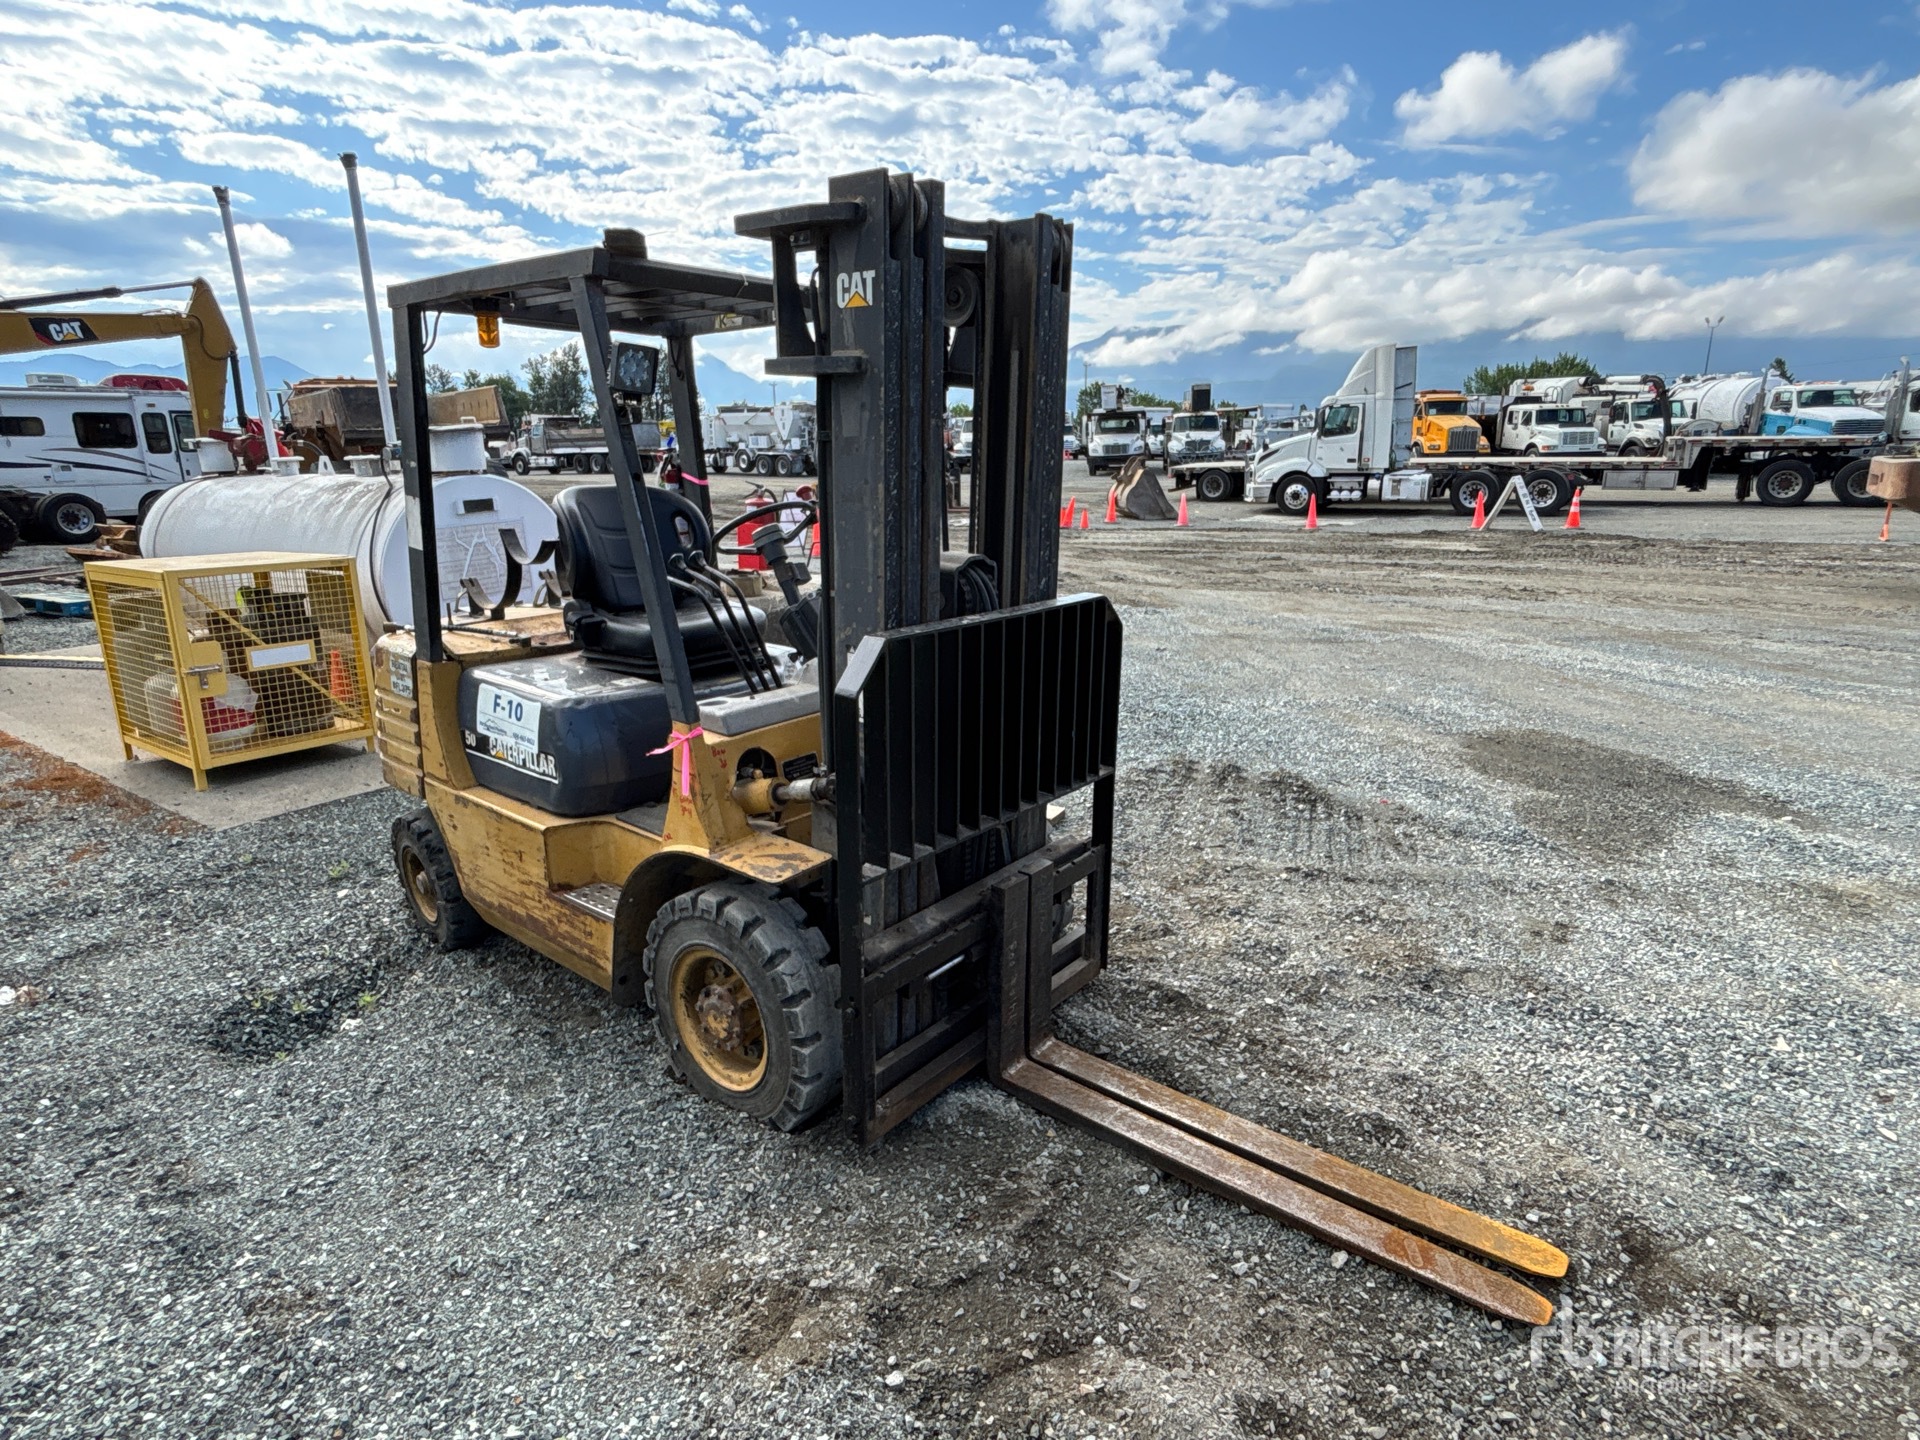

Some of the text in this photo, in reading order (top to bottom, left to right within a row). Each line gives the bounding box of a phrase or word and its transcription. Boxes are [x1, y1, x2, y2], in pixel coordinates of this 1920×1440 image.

[836, 269, 876, 309] CAT
[48, 321, 85, 342] CAT
[493, 693, 524, 722] F-10
[464, 729, 477, 747] 50
[488, 735, 557, 778] CATERPILLAR
